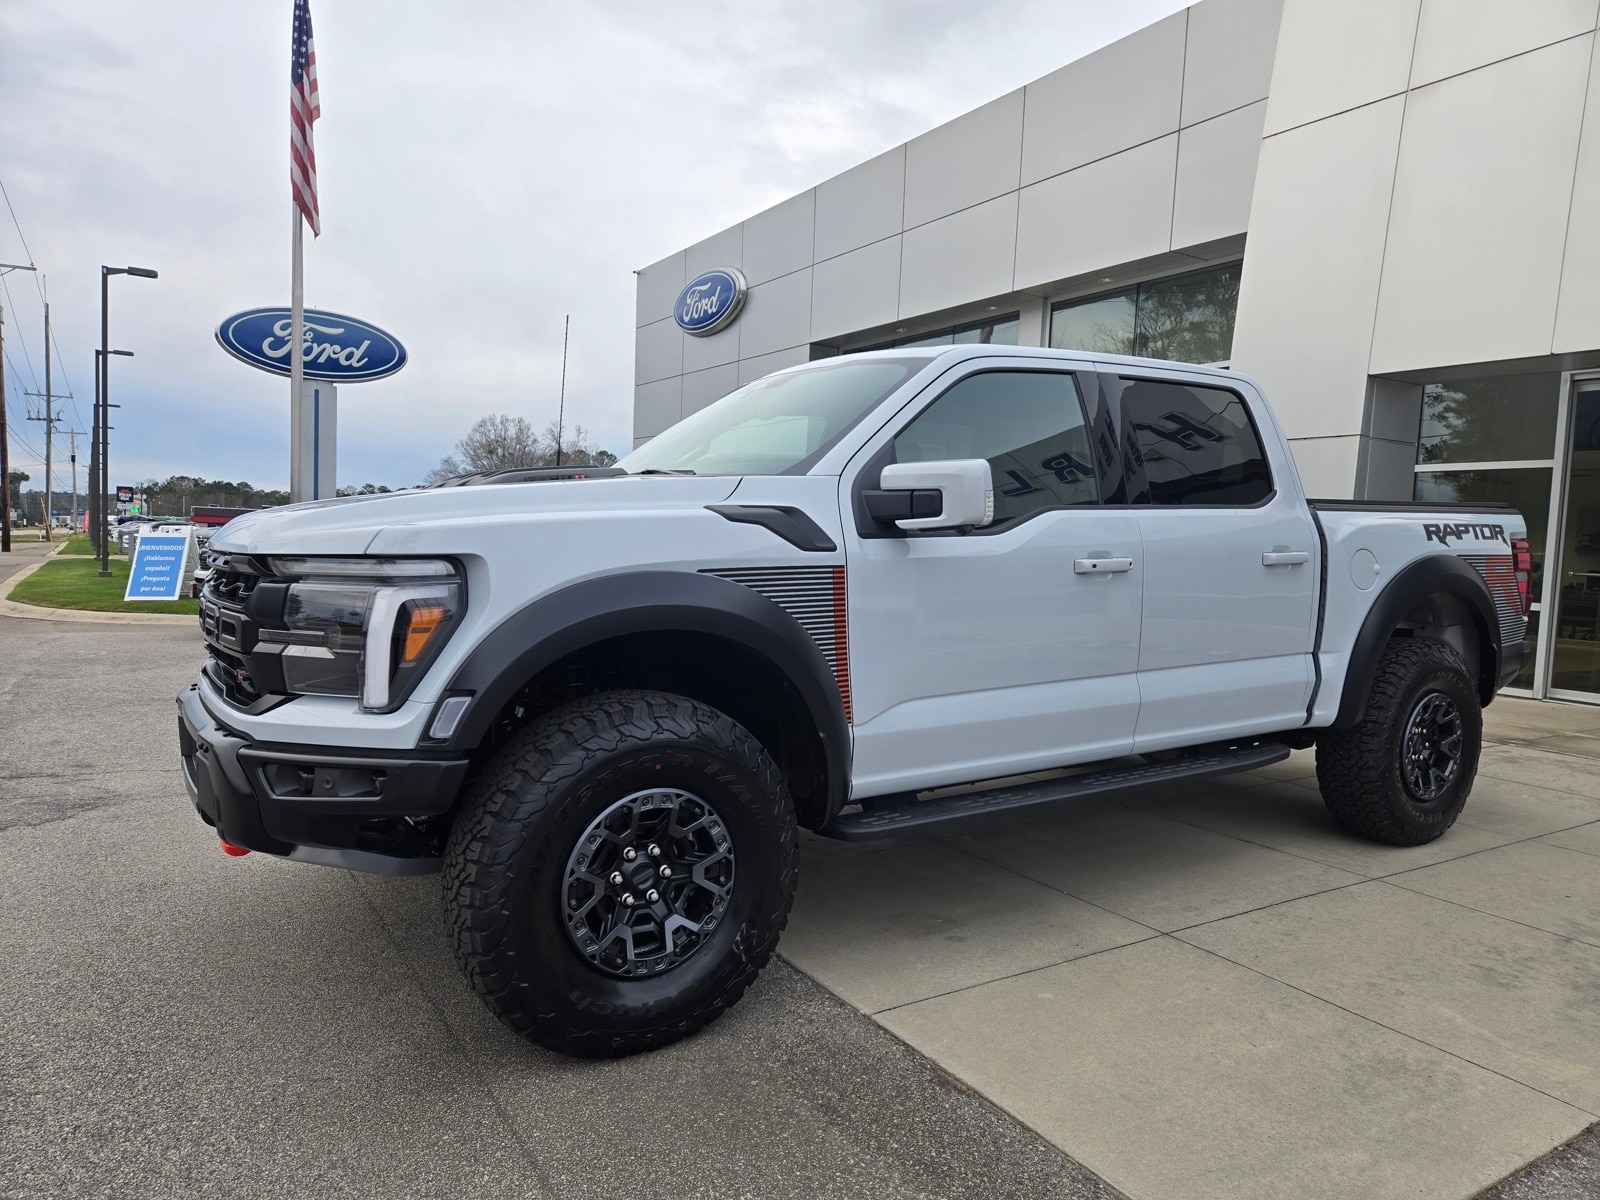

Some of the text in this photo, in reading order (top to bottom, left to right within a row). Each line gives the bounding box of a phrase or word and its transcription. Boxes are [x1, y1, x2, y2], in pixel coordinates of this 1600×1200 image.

[683, 282, 721, 322] Ford
[262, 319, 371, 368] Ford
[1422, 523, 1510, 548] RAPTOR
